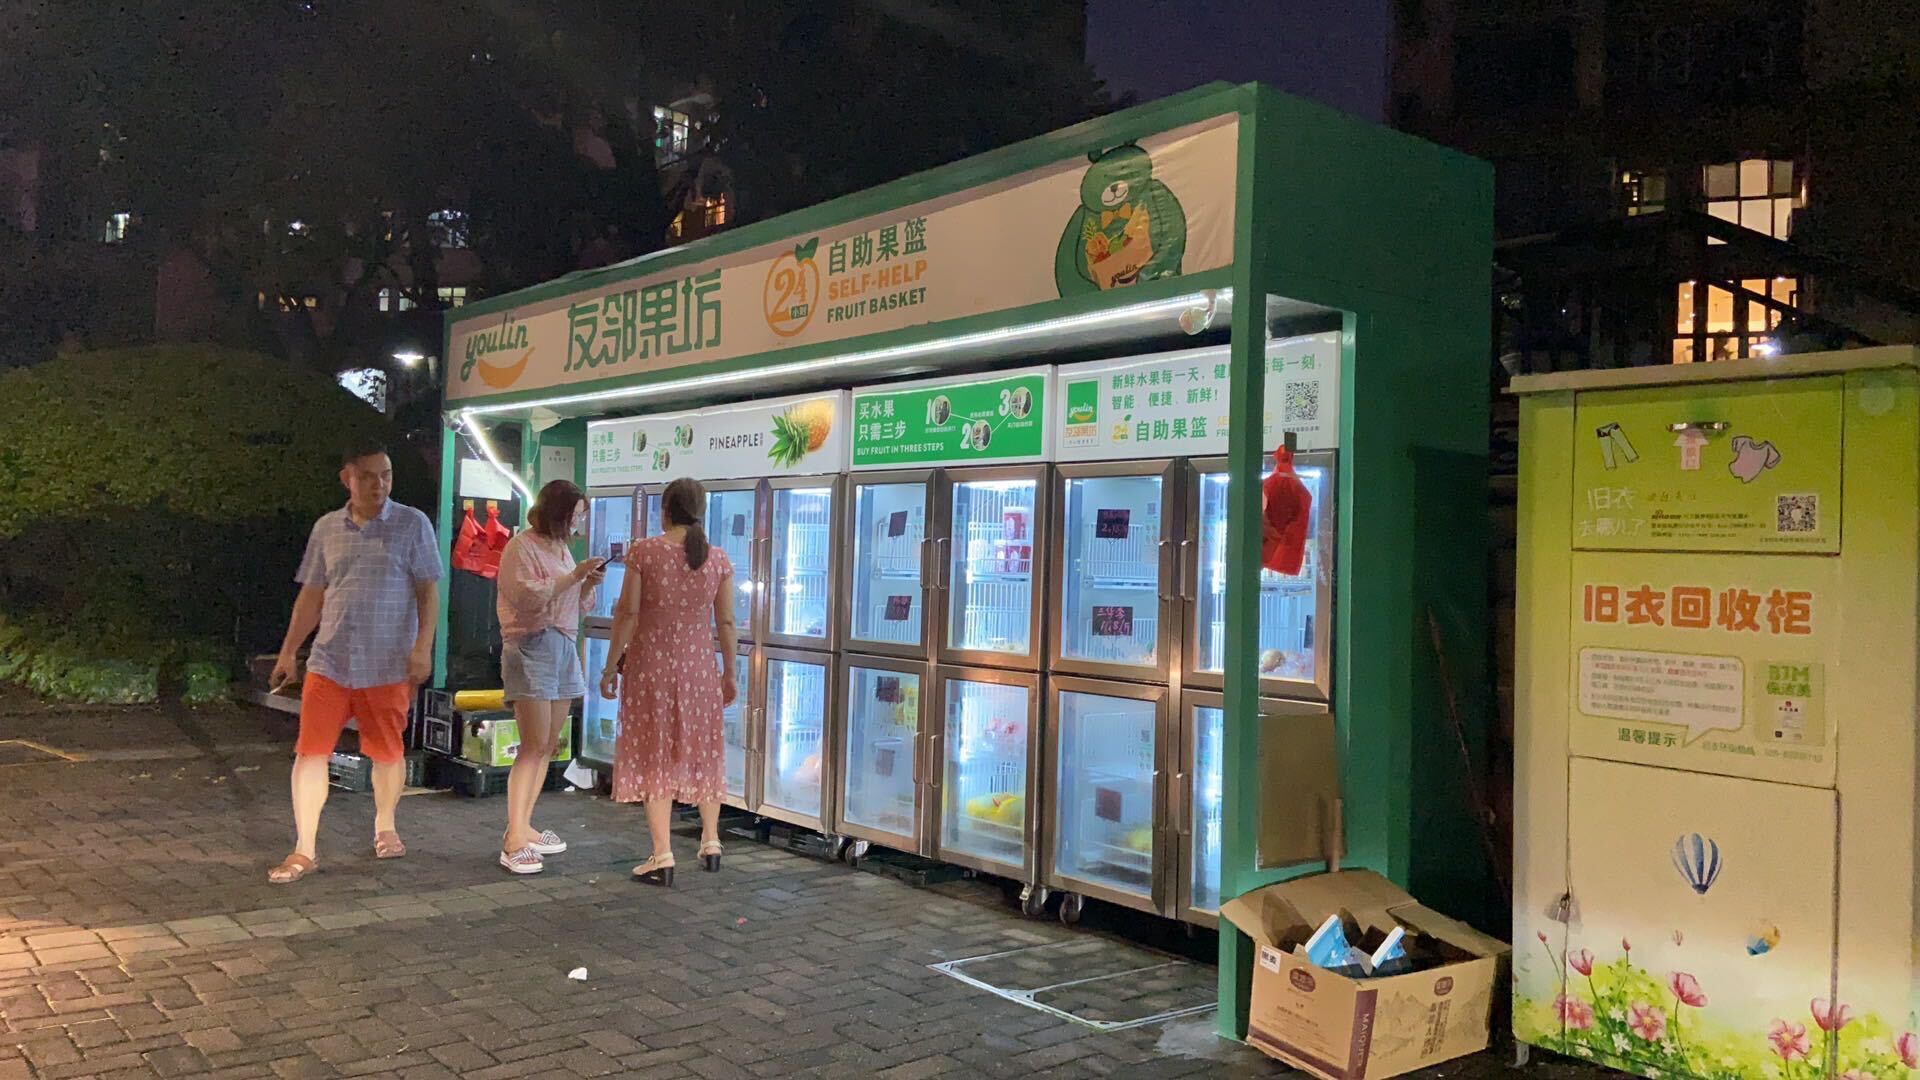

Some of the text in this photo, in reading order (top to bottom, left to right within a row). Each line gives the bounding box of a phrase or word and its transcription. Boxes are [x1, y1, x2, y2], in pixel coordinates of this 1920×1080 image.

[828, 217, 928, 276] 自助果篮
[828, 259, 928, 300] SELF-HELP
[1110, 262, 1139, 288] youlin
[767, 267, 808, 325] 24
[827, 287, 927, 323] FRUIT BASKET
[563, 268, 722, 373] 友邻果坊
[460, 312, 529, 382] youlin
[1111, 363, 1231, 390] 新鲜水果每一天，健
[859, 399, 895, 420] 买水果
[998, 388, 1011, 417] 3
[709, 432, 759, 450] PINEAPPLE
[858, 419, 907, 442] 只需三步
[960, 422, 972, 449] 2
[1135, 416, 1208, 442] 自助果篮
[857, 442, 945, 456] BUY FRUIT IN THREE STEPS
[1588, 488, 1636, 510] 旧衣
[1583, 584, 1813, 635] 旧衣回收柜
[1617, 727, 1677, 748] 温馨提示
